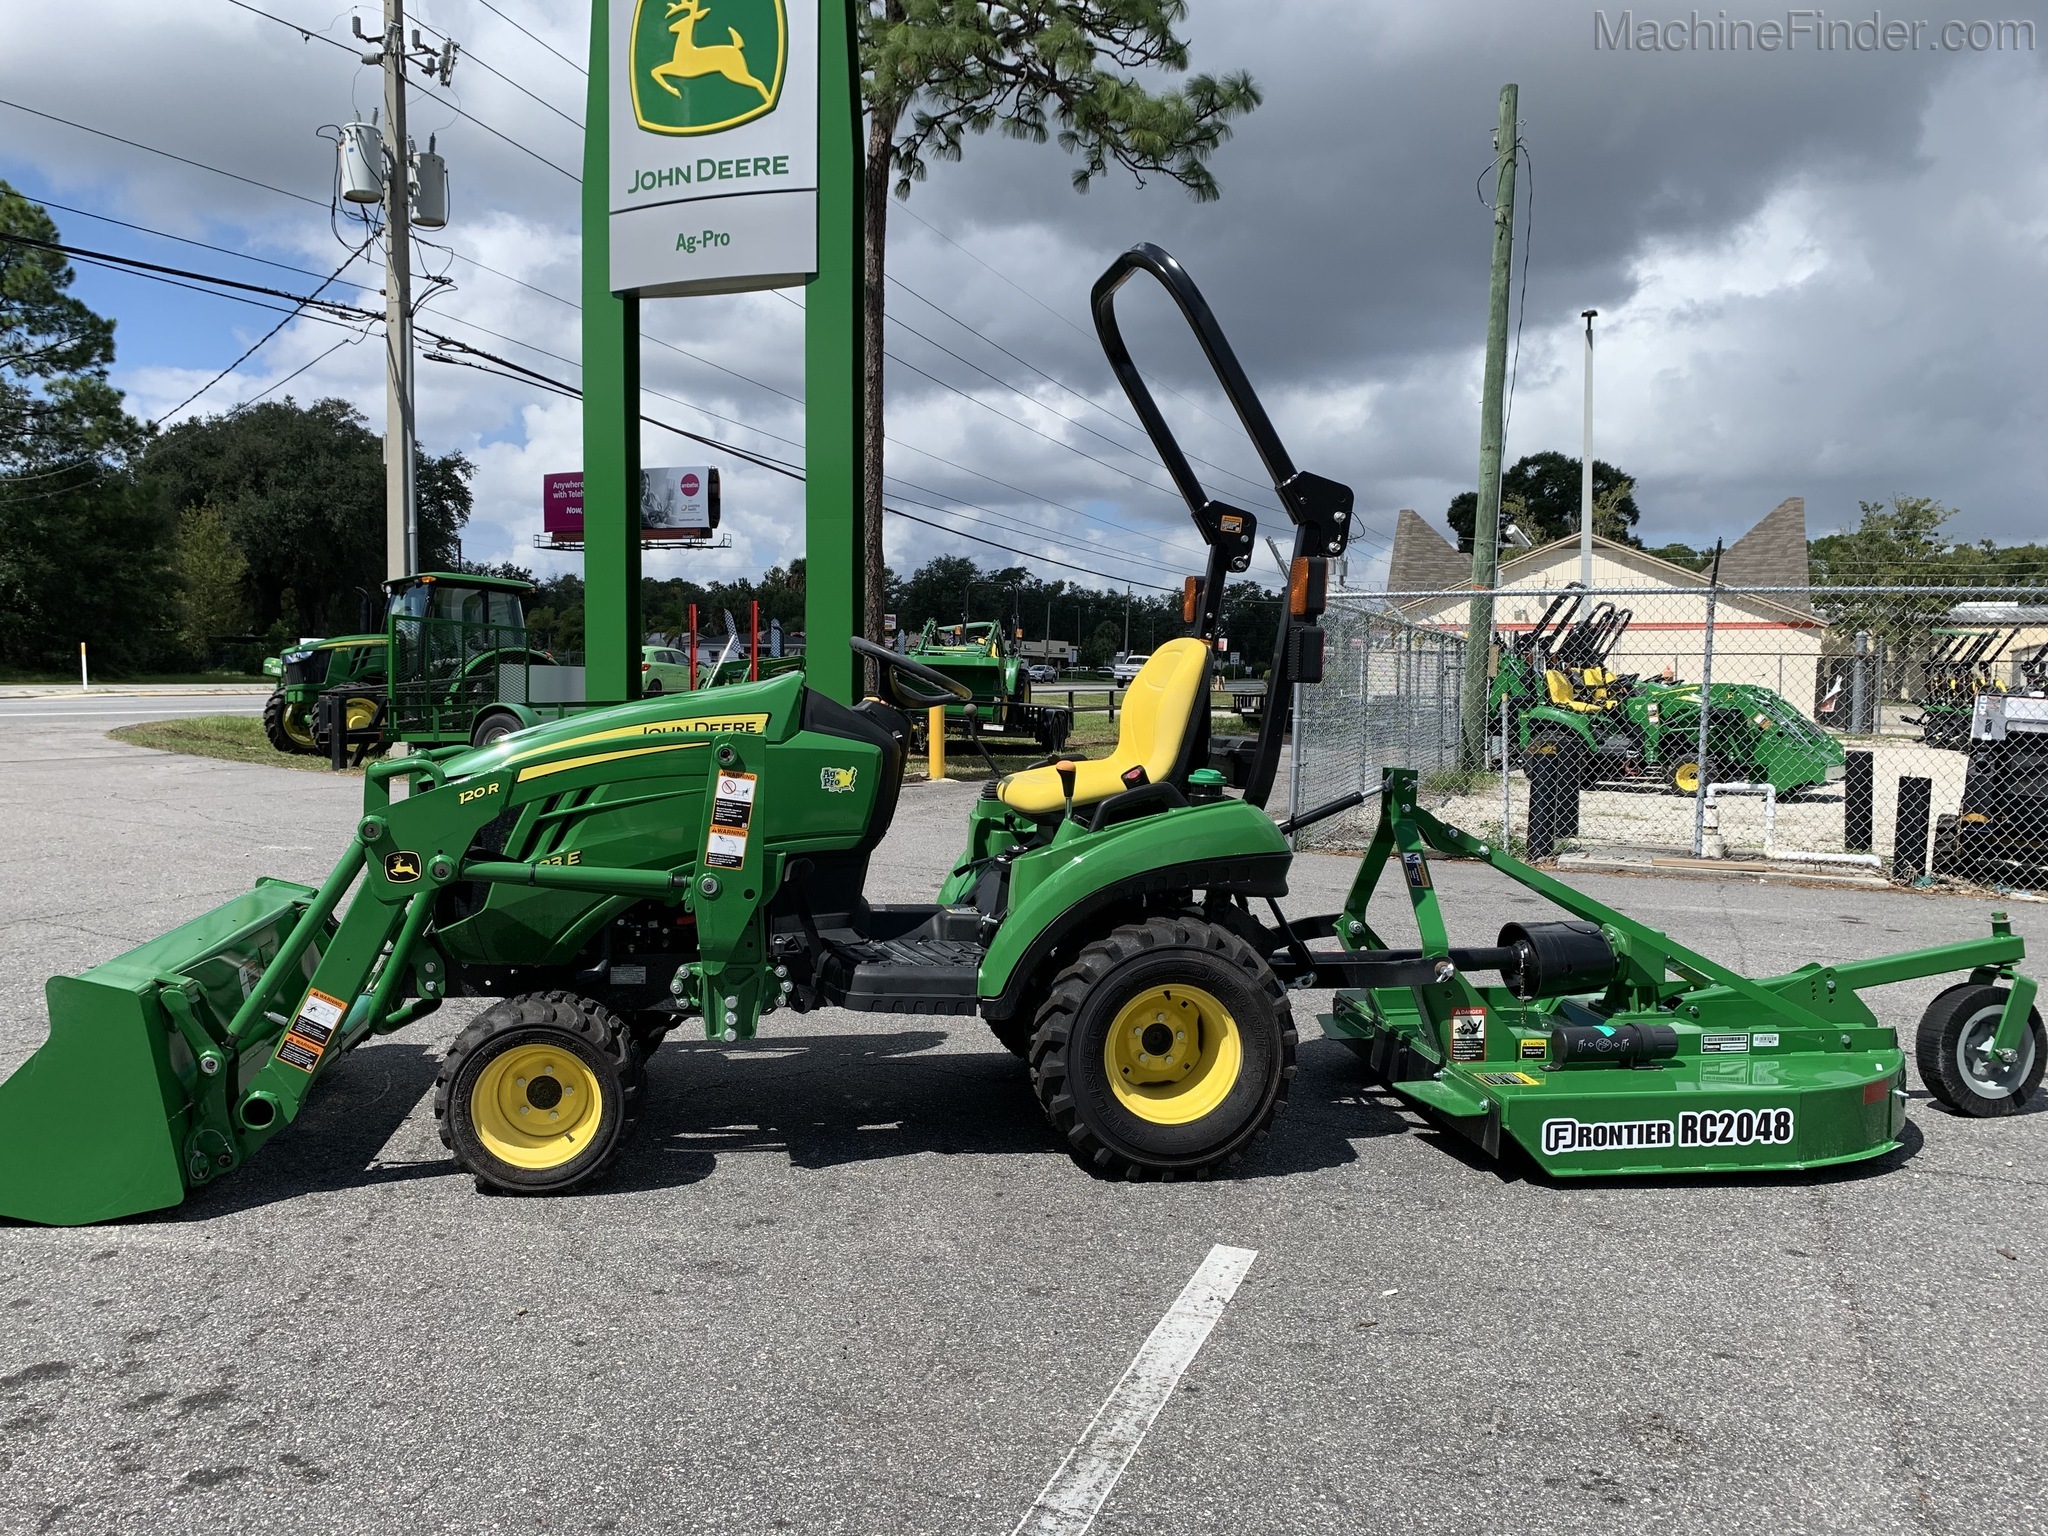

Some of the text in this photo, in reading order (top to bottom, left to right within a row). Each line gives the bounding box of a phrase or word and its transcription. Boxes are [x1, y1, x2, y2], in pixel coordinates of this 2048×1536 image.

[627, 155, 790, 194] JOHN DEERE
[675, 229, 731, 254] Ag-Pro
[553, 491, 567, 499] with
[566, 506, 583, 515] Now,
[726, 771, 756, 781] WARNING
[823, 778, 841, 787] Pro
[458, 782, 500, 805] 120 R
[717, 828, 747, 837] WARNING
[567, 850, 581, 866] E
[319, 993, 343, 1008] WARNING
[295, 1039, 320, 1053] WARNING
[1082, 1042, 1147, 1146] CARLISLE
[1544, 1110, 1791, 1152] FRONTIER RC2048
